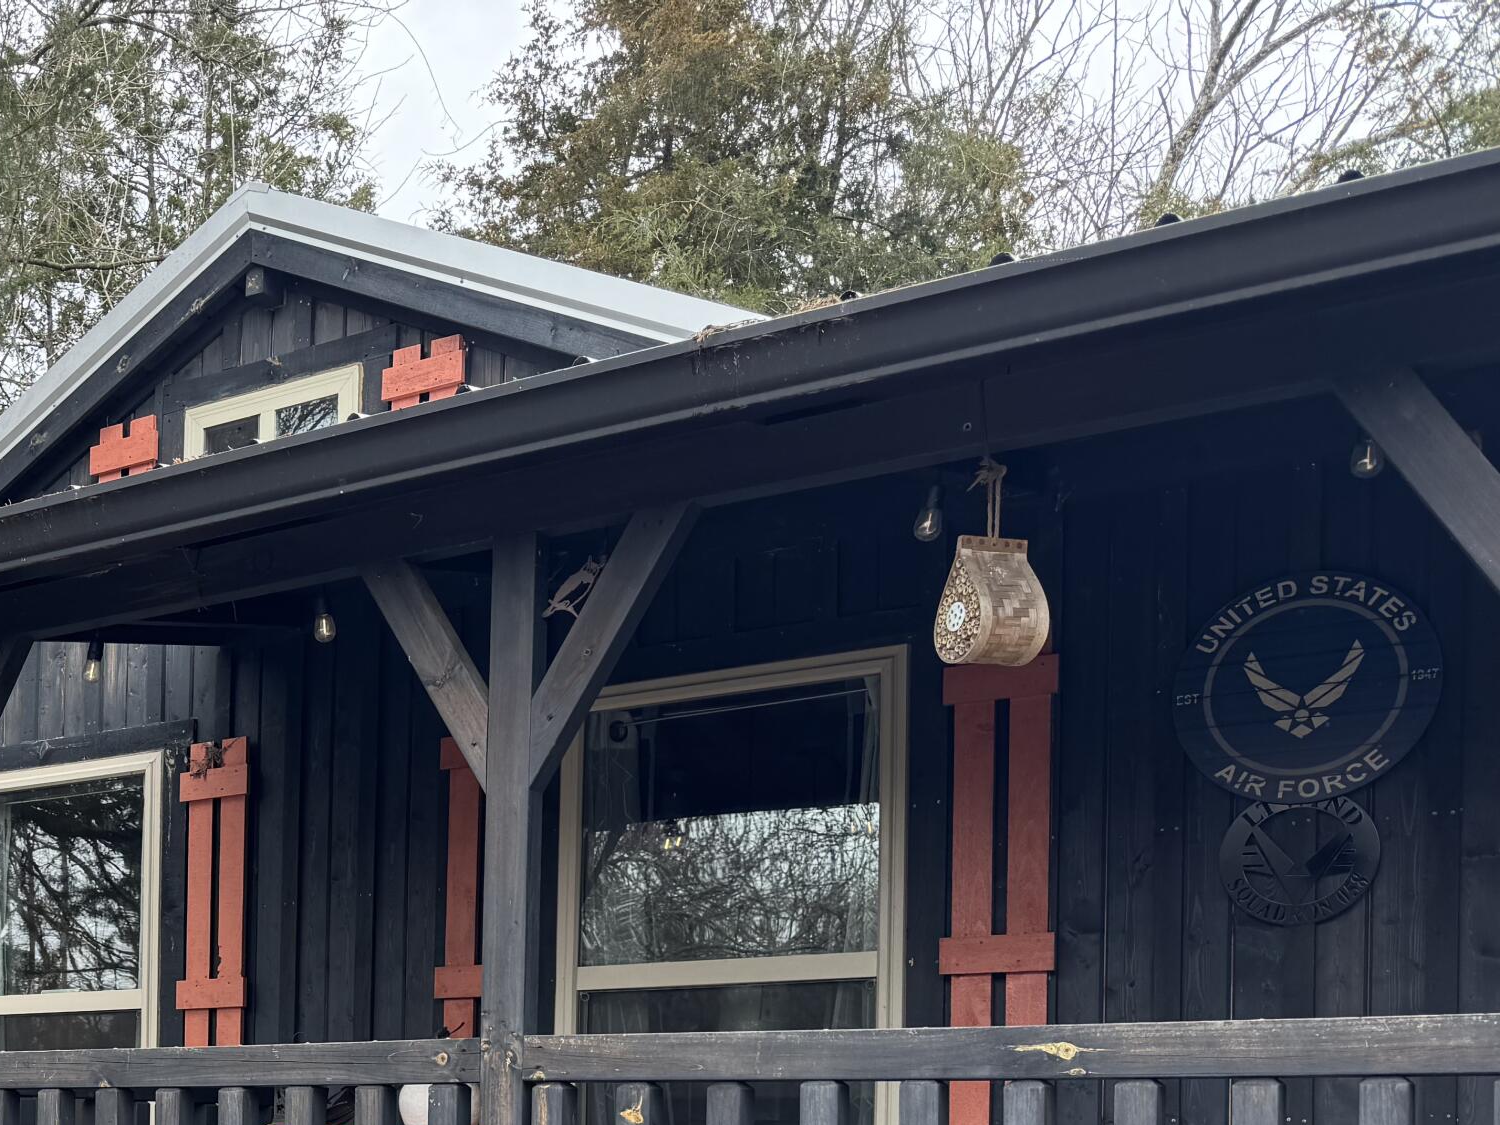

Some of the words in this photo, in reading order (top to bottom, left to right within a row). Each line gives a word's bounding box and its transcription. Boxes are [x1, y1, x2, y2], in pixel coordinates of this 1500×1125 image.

[1195, 580, 1298, 654] UNITED
[1308, 575, 1418, 632] STATES
[1176, 693, 1200, 705] EST
[1214, 763, 1267, 797] AIR
[1277, 747, 1390, 800] FORCE
